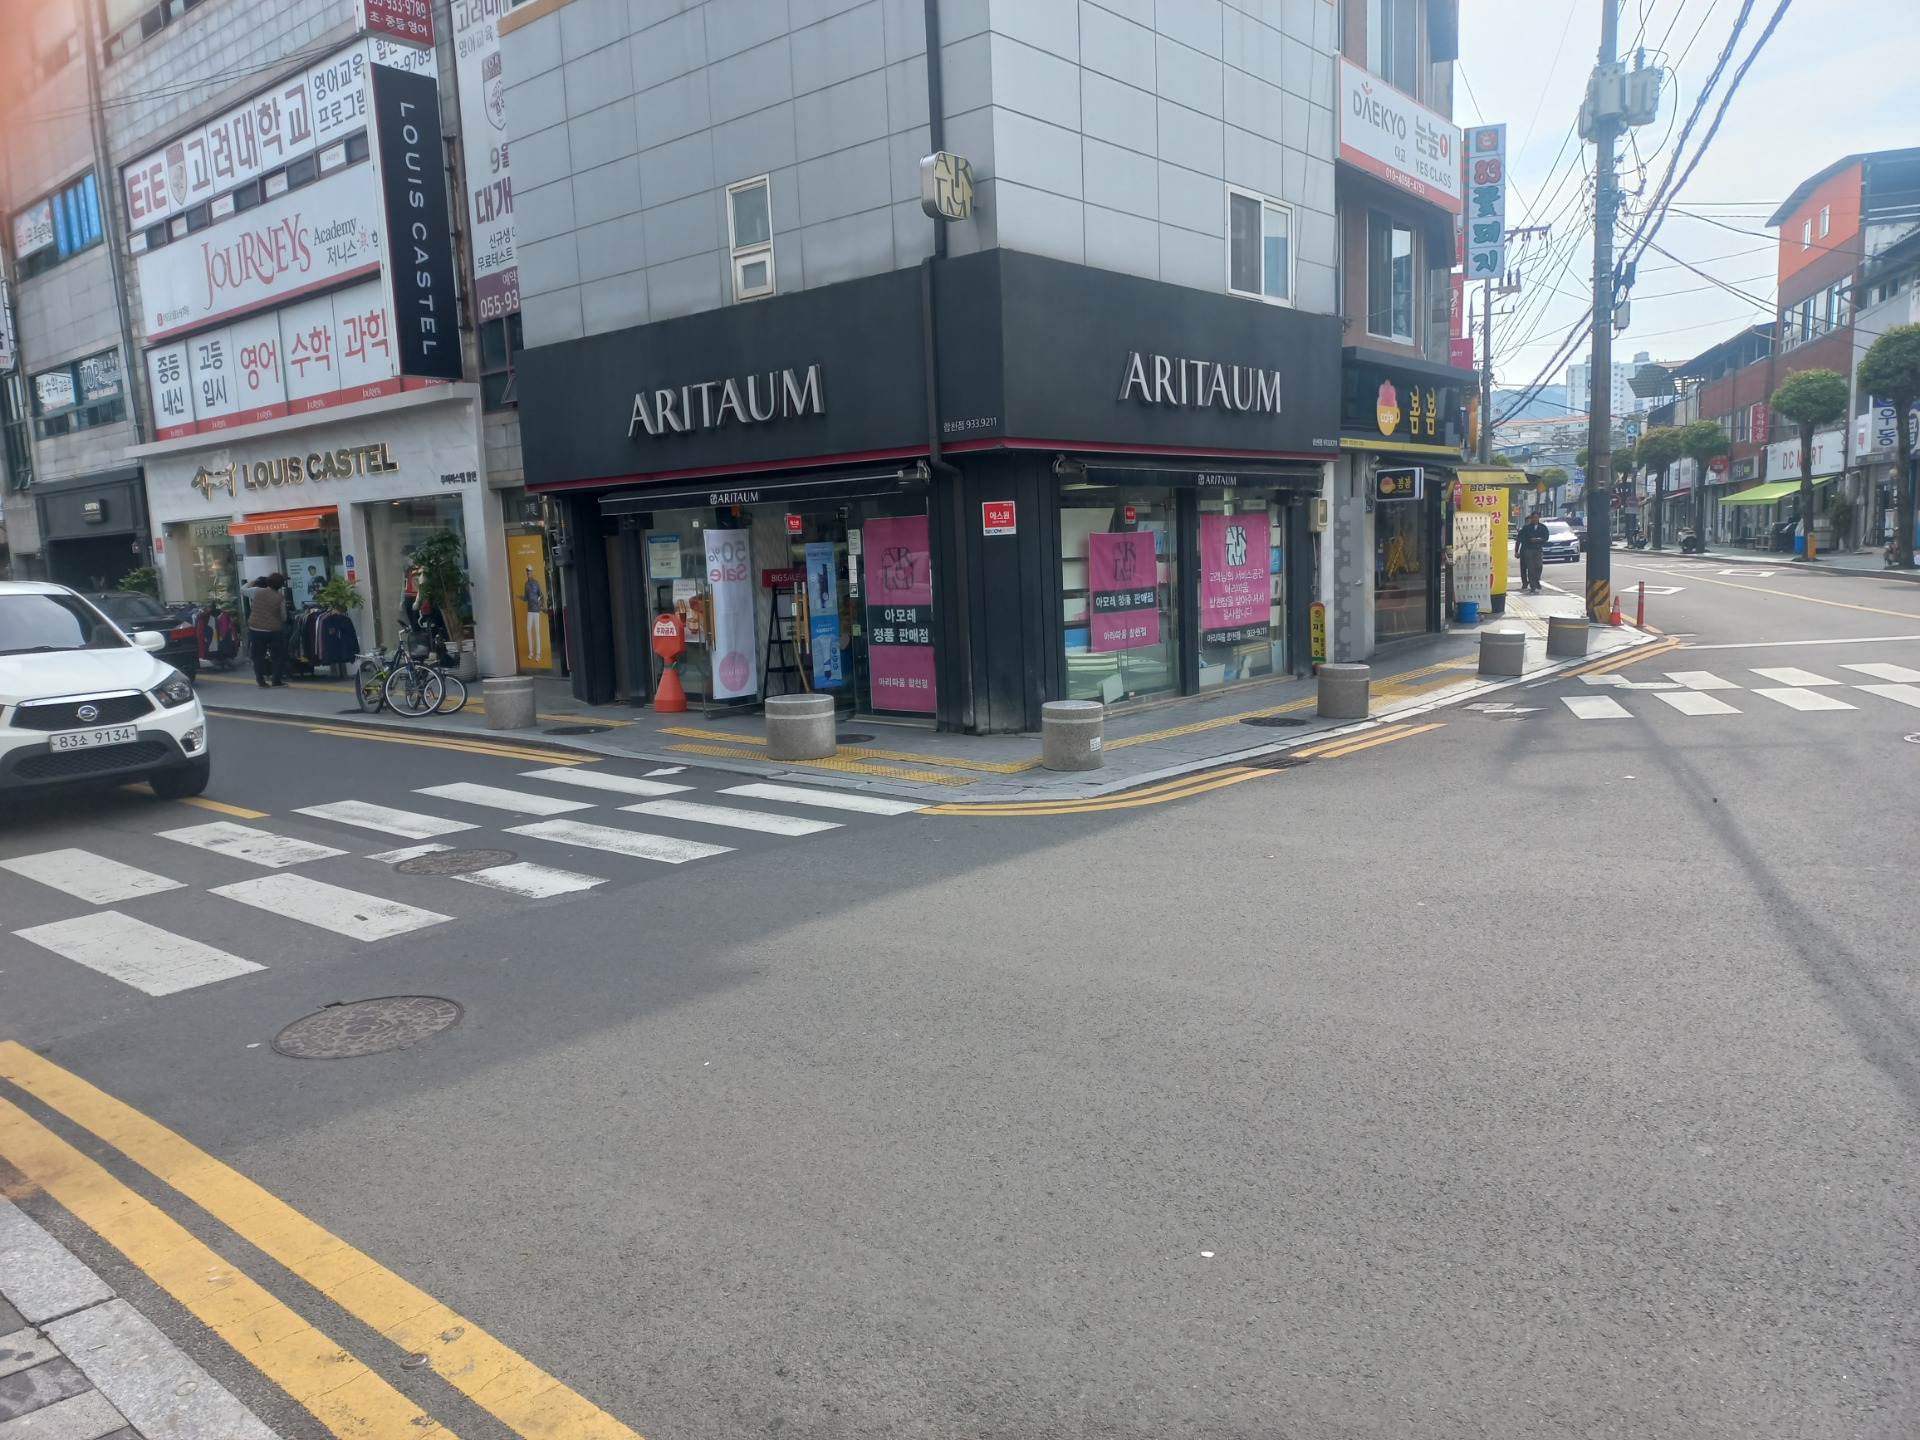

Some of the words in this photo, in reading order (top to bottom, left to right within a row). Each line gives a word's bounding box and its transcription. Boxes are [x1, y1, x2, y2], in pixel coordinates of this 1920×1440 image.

[367, 0, 426, 19] -933-9789
[408, 20, 428, 36] 영어
[459, 25, 494, 58] 영어교육
[314, 53, 364, 100] 영어교육
[1353, 89, 1406, 140] DAEKYO
[188, 83, 312, 192] 고려대학교
[1415, 115, 1452, 166] 눈높이
[1416, 158, 1428, 178] YES
[1430, 166, 1452, 188] CLASS
[314, 218, 356, 246] Academy
[400, 102, 424, 209] LOUIS
[412, 222, 436, 355] CASTEL
[201, 213, 312, 310] JOURNEYS
[326, 240, 358, 266] 저니스
[502, 271, 519, 286] 예약
[343, 308, 390, 362] 과학
[199, 340, 224, 371] 고등
[240, 340, 280, 390] 영어
[290, 325, 332, 378] 수학
[157, 354, 180, 384] 중등
[1118, 351, 1281, 414] ARITAUM
[162, 386, 184, 416] 내신
[203, 375, 228, 408] 입시
[628, 364, 826, 438] ARITAUM
[966, 417, 997, 429] 933.9211
[1380, 411, 1394, 423] cafe
[1877, 408, 1897, 446] 우동
[242, 456, 306, 490] LOUIS
[306, 442, 398, 481] CASTEL
[1782, 451, 1794, 470] DC
[1797, 445, 1824, 468] MRT
[1206, 475, 1236, 486] ARITAUM
[718, 491, 758, 504] ARITAUM
[1474, 495, 1498, 508] 직화
[989, 511, 1010, 520] 에스원
[771, 573, 783, 582] BIG
[884, 608, 916, 624] 아모레
[874, 628, 895, 644] 정품
[898, 628, 929, 644] 판매점
[878, 678, 906, 688] 아리따움
[59, 735, 88, 748] 83소
[94, 730, 131, 744] 9134
